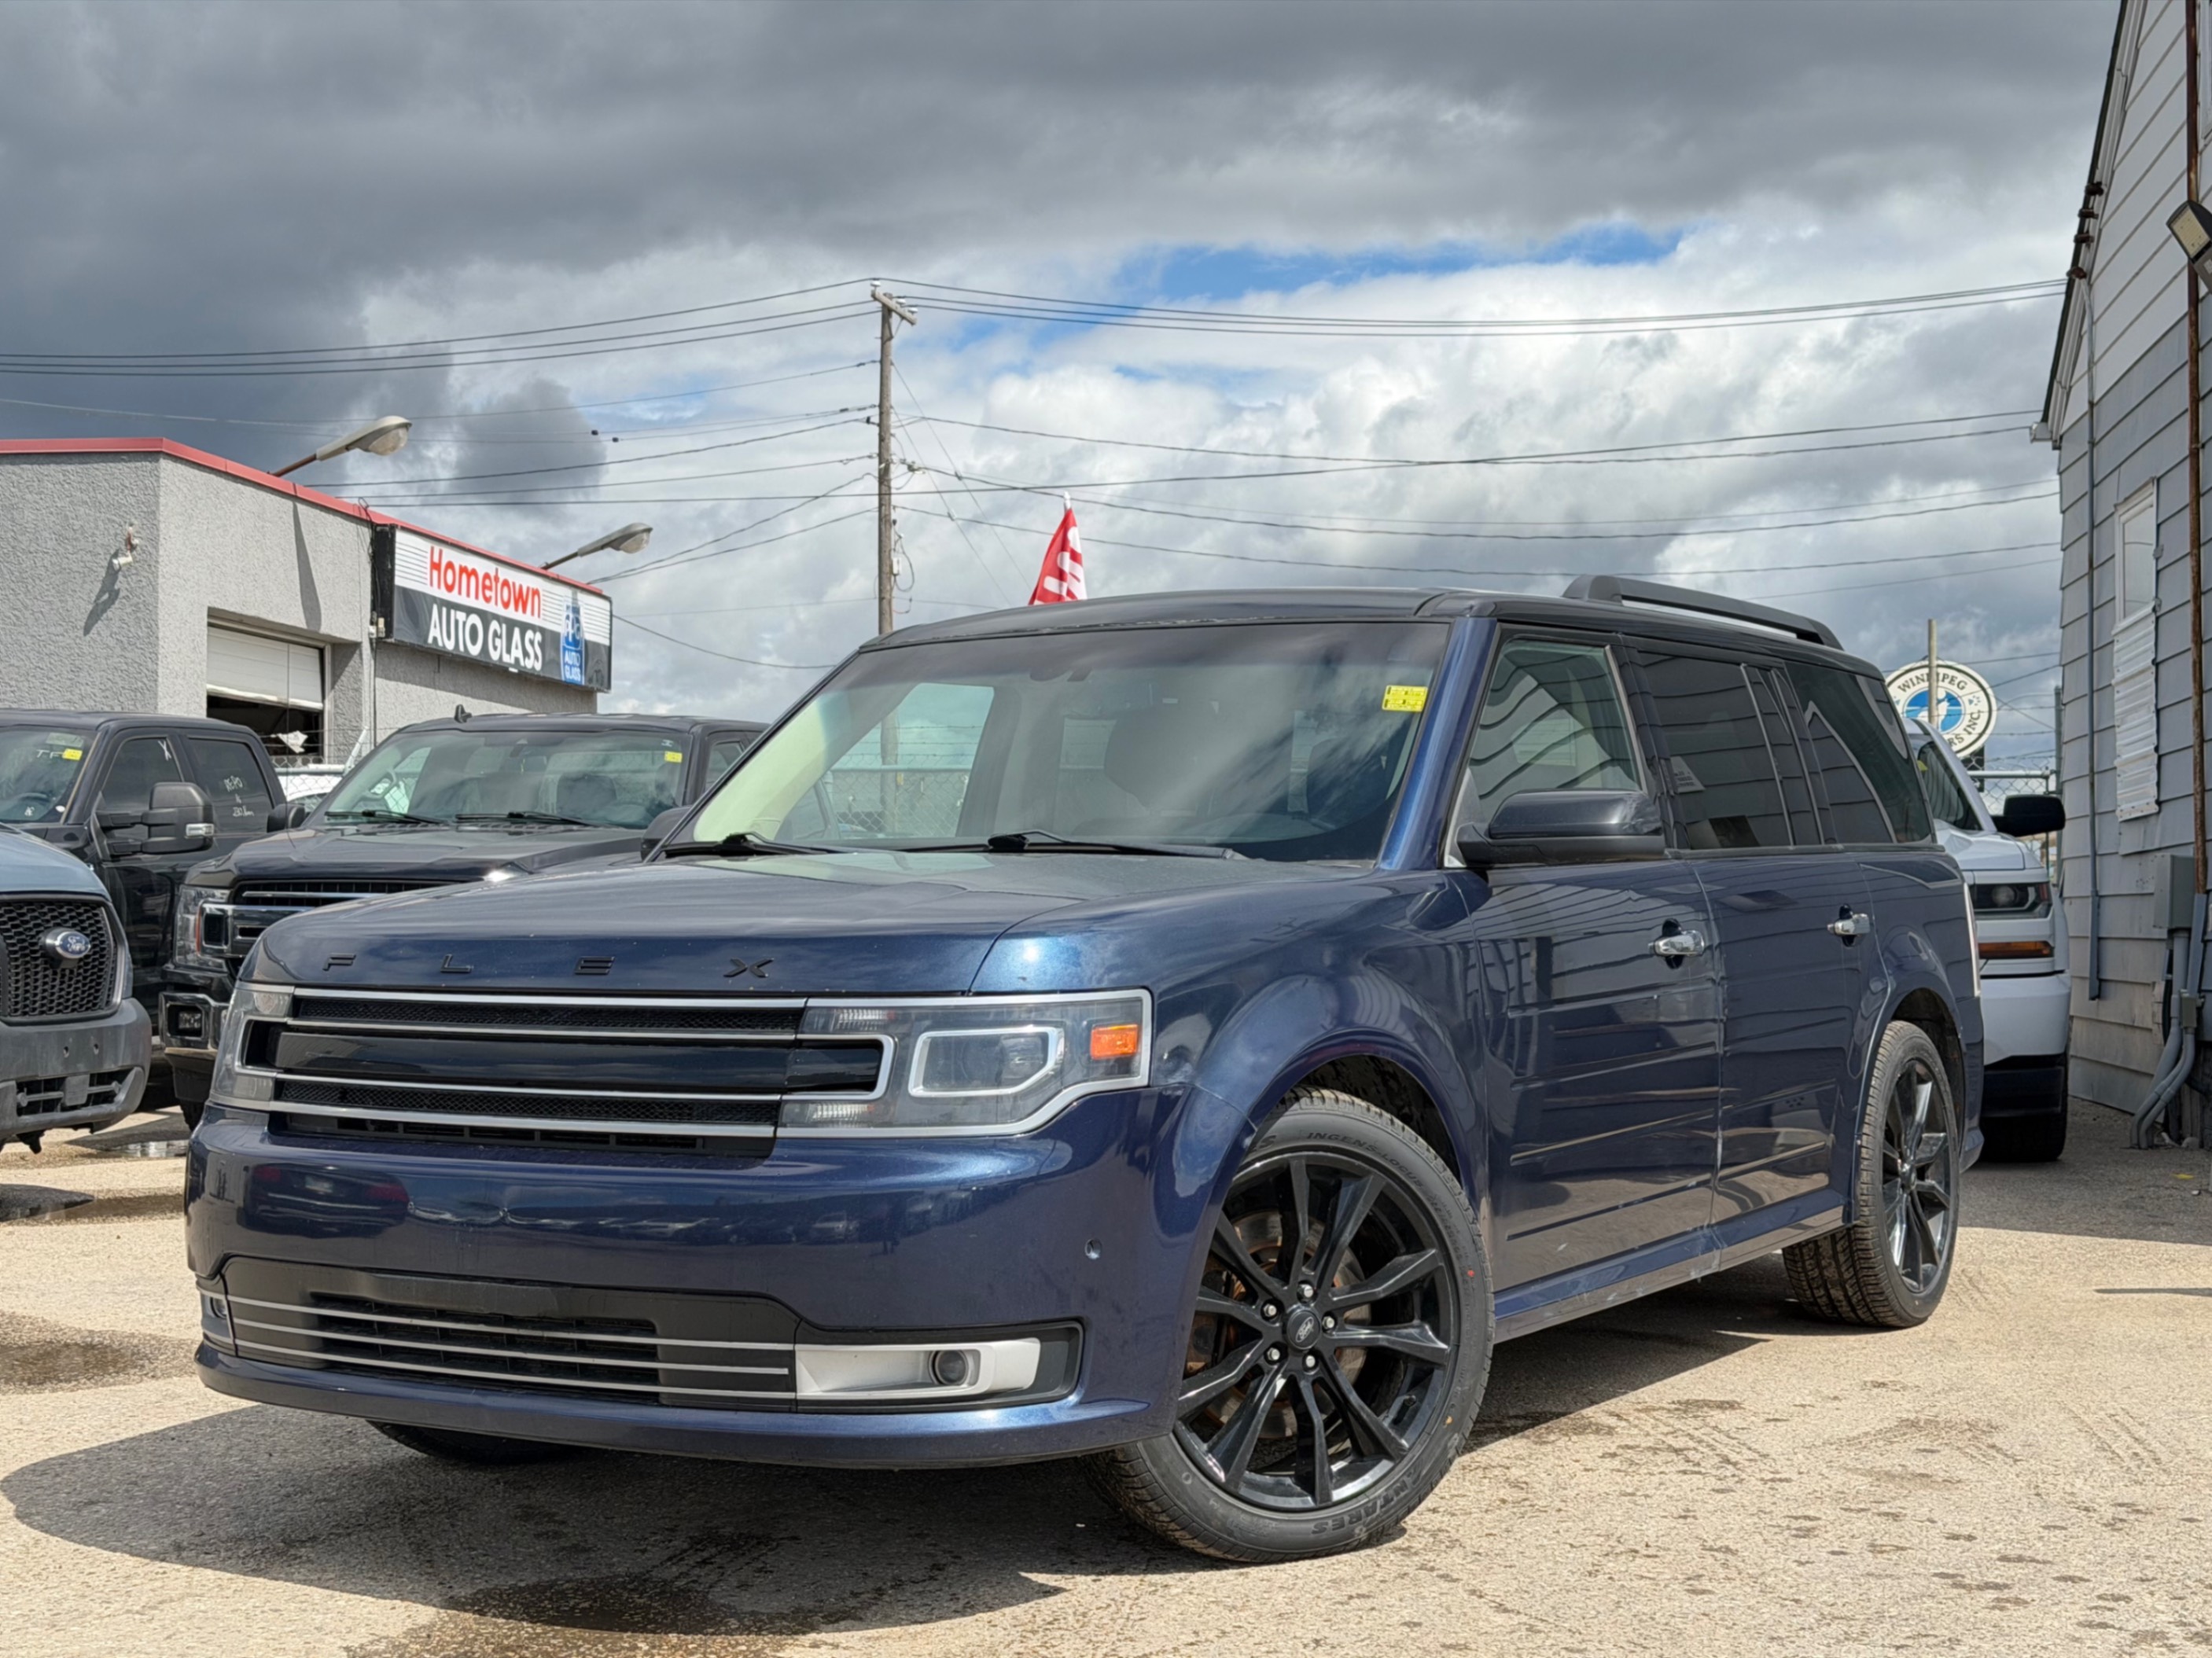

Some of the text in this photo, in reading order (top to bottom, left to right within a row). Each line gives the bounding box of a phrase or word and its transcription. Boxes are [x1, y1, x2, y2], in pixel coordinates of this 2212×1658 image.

[429, 545, 542, 619] Hometown
[428, 604, 543, 671] AUTO GLASS
[322, 953, 775, 980] FLEX
